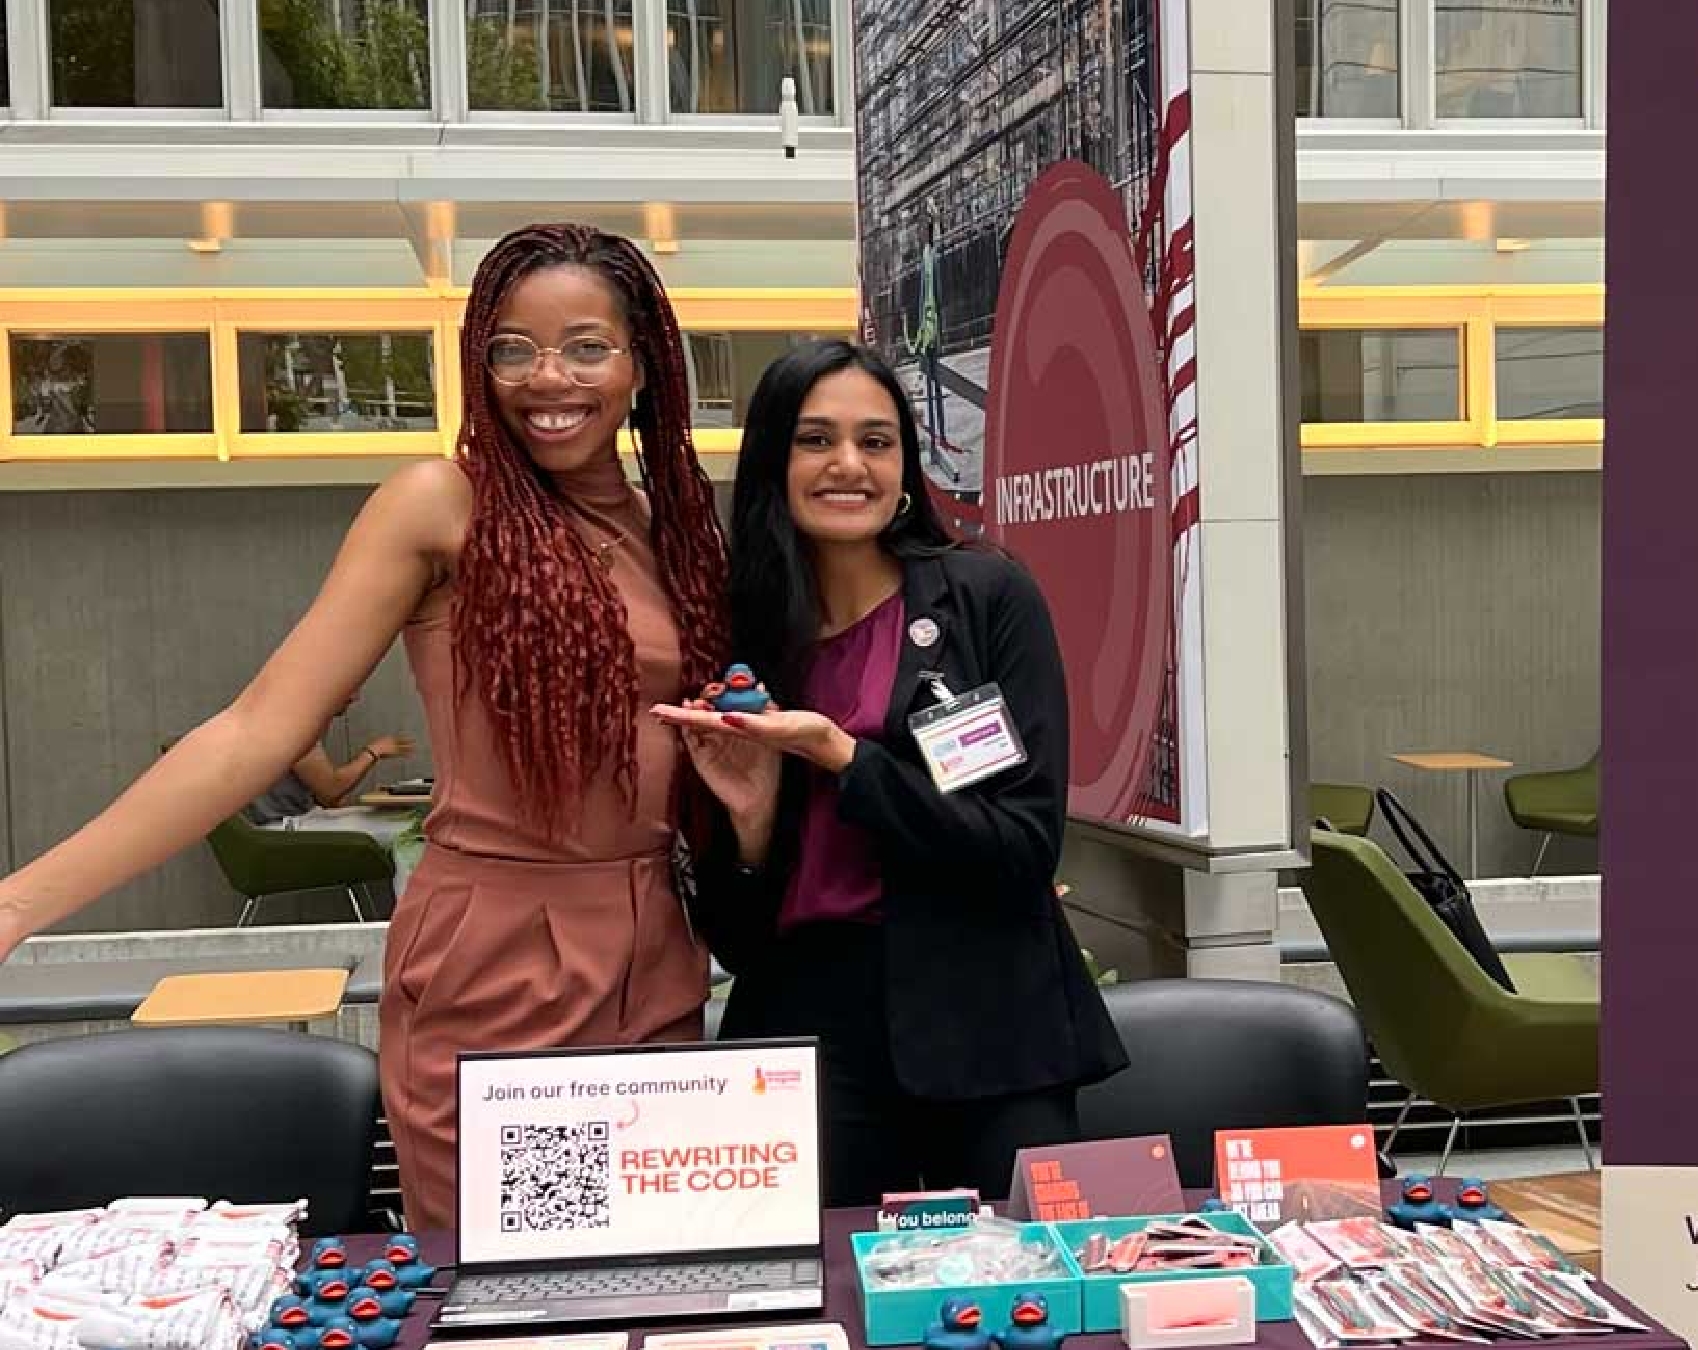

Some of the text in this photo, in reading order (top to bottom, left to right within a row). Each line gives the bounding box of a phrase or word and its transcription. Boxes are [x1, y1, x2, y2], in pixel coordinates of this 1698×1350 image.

[995, 451, 1155, 525] INFRASTRUCTURE
[482, 1075, 729, 1101] Join our free community
[619, 1141, 798, 1170] REWRITING
[620, 1167, 779, 1194] THE CODE
